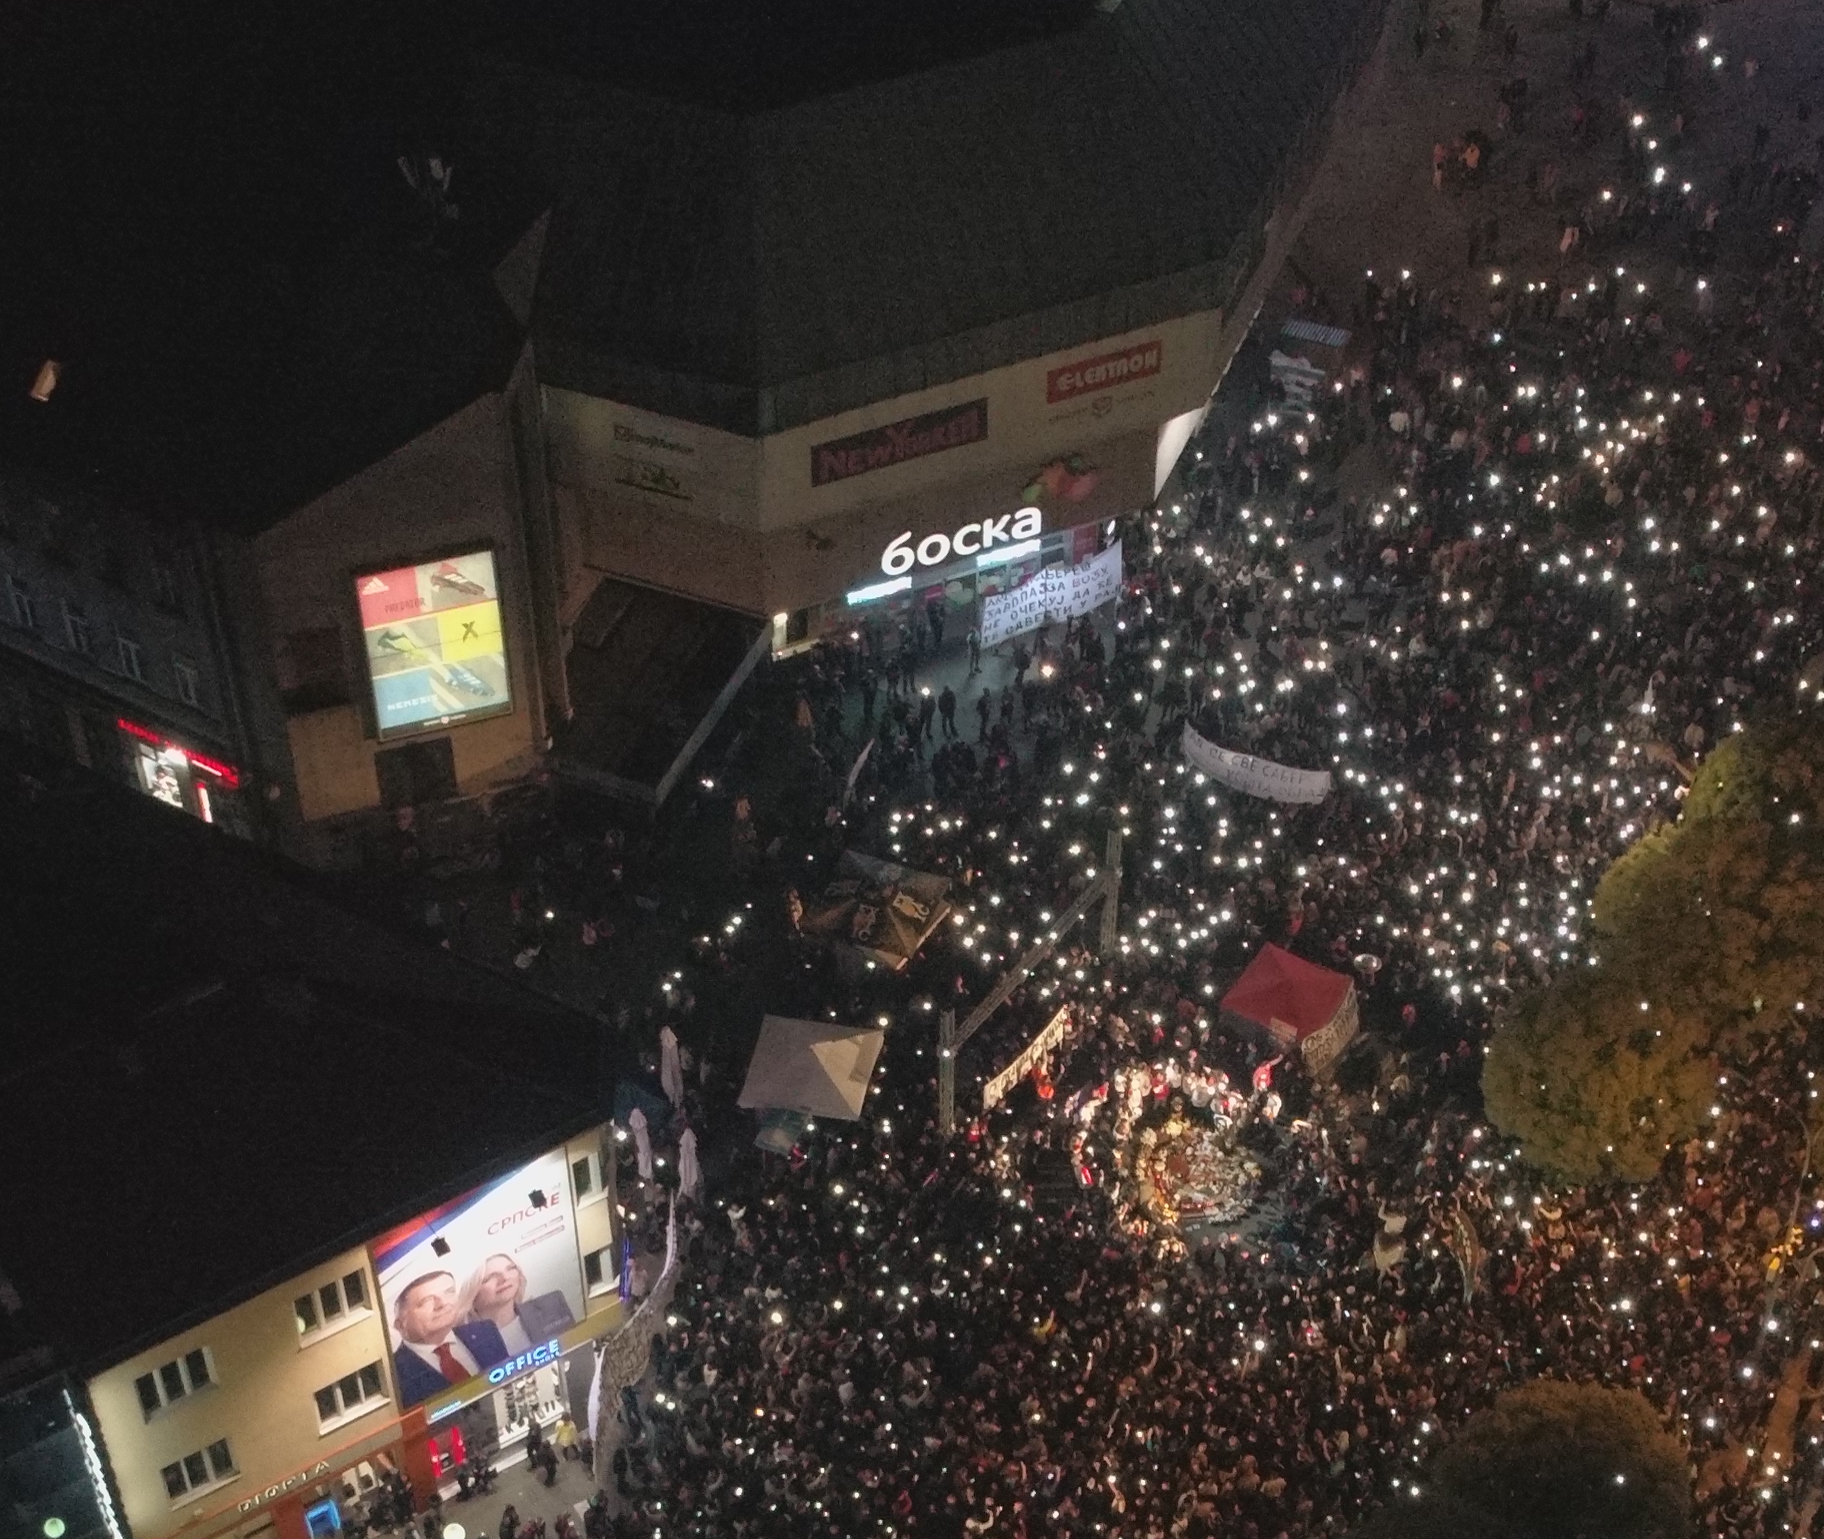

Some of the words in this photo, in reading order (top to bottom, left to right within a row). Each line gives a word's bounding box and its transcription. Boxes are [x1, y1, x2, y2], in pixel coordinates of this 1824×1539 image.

[881, 506, 1041, 575] боска
[385, 598, 426, 613] PREDATOR
[489, 1338, 558, 1383] OFFICE
